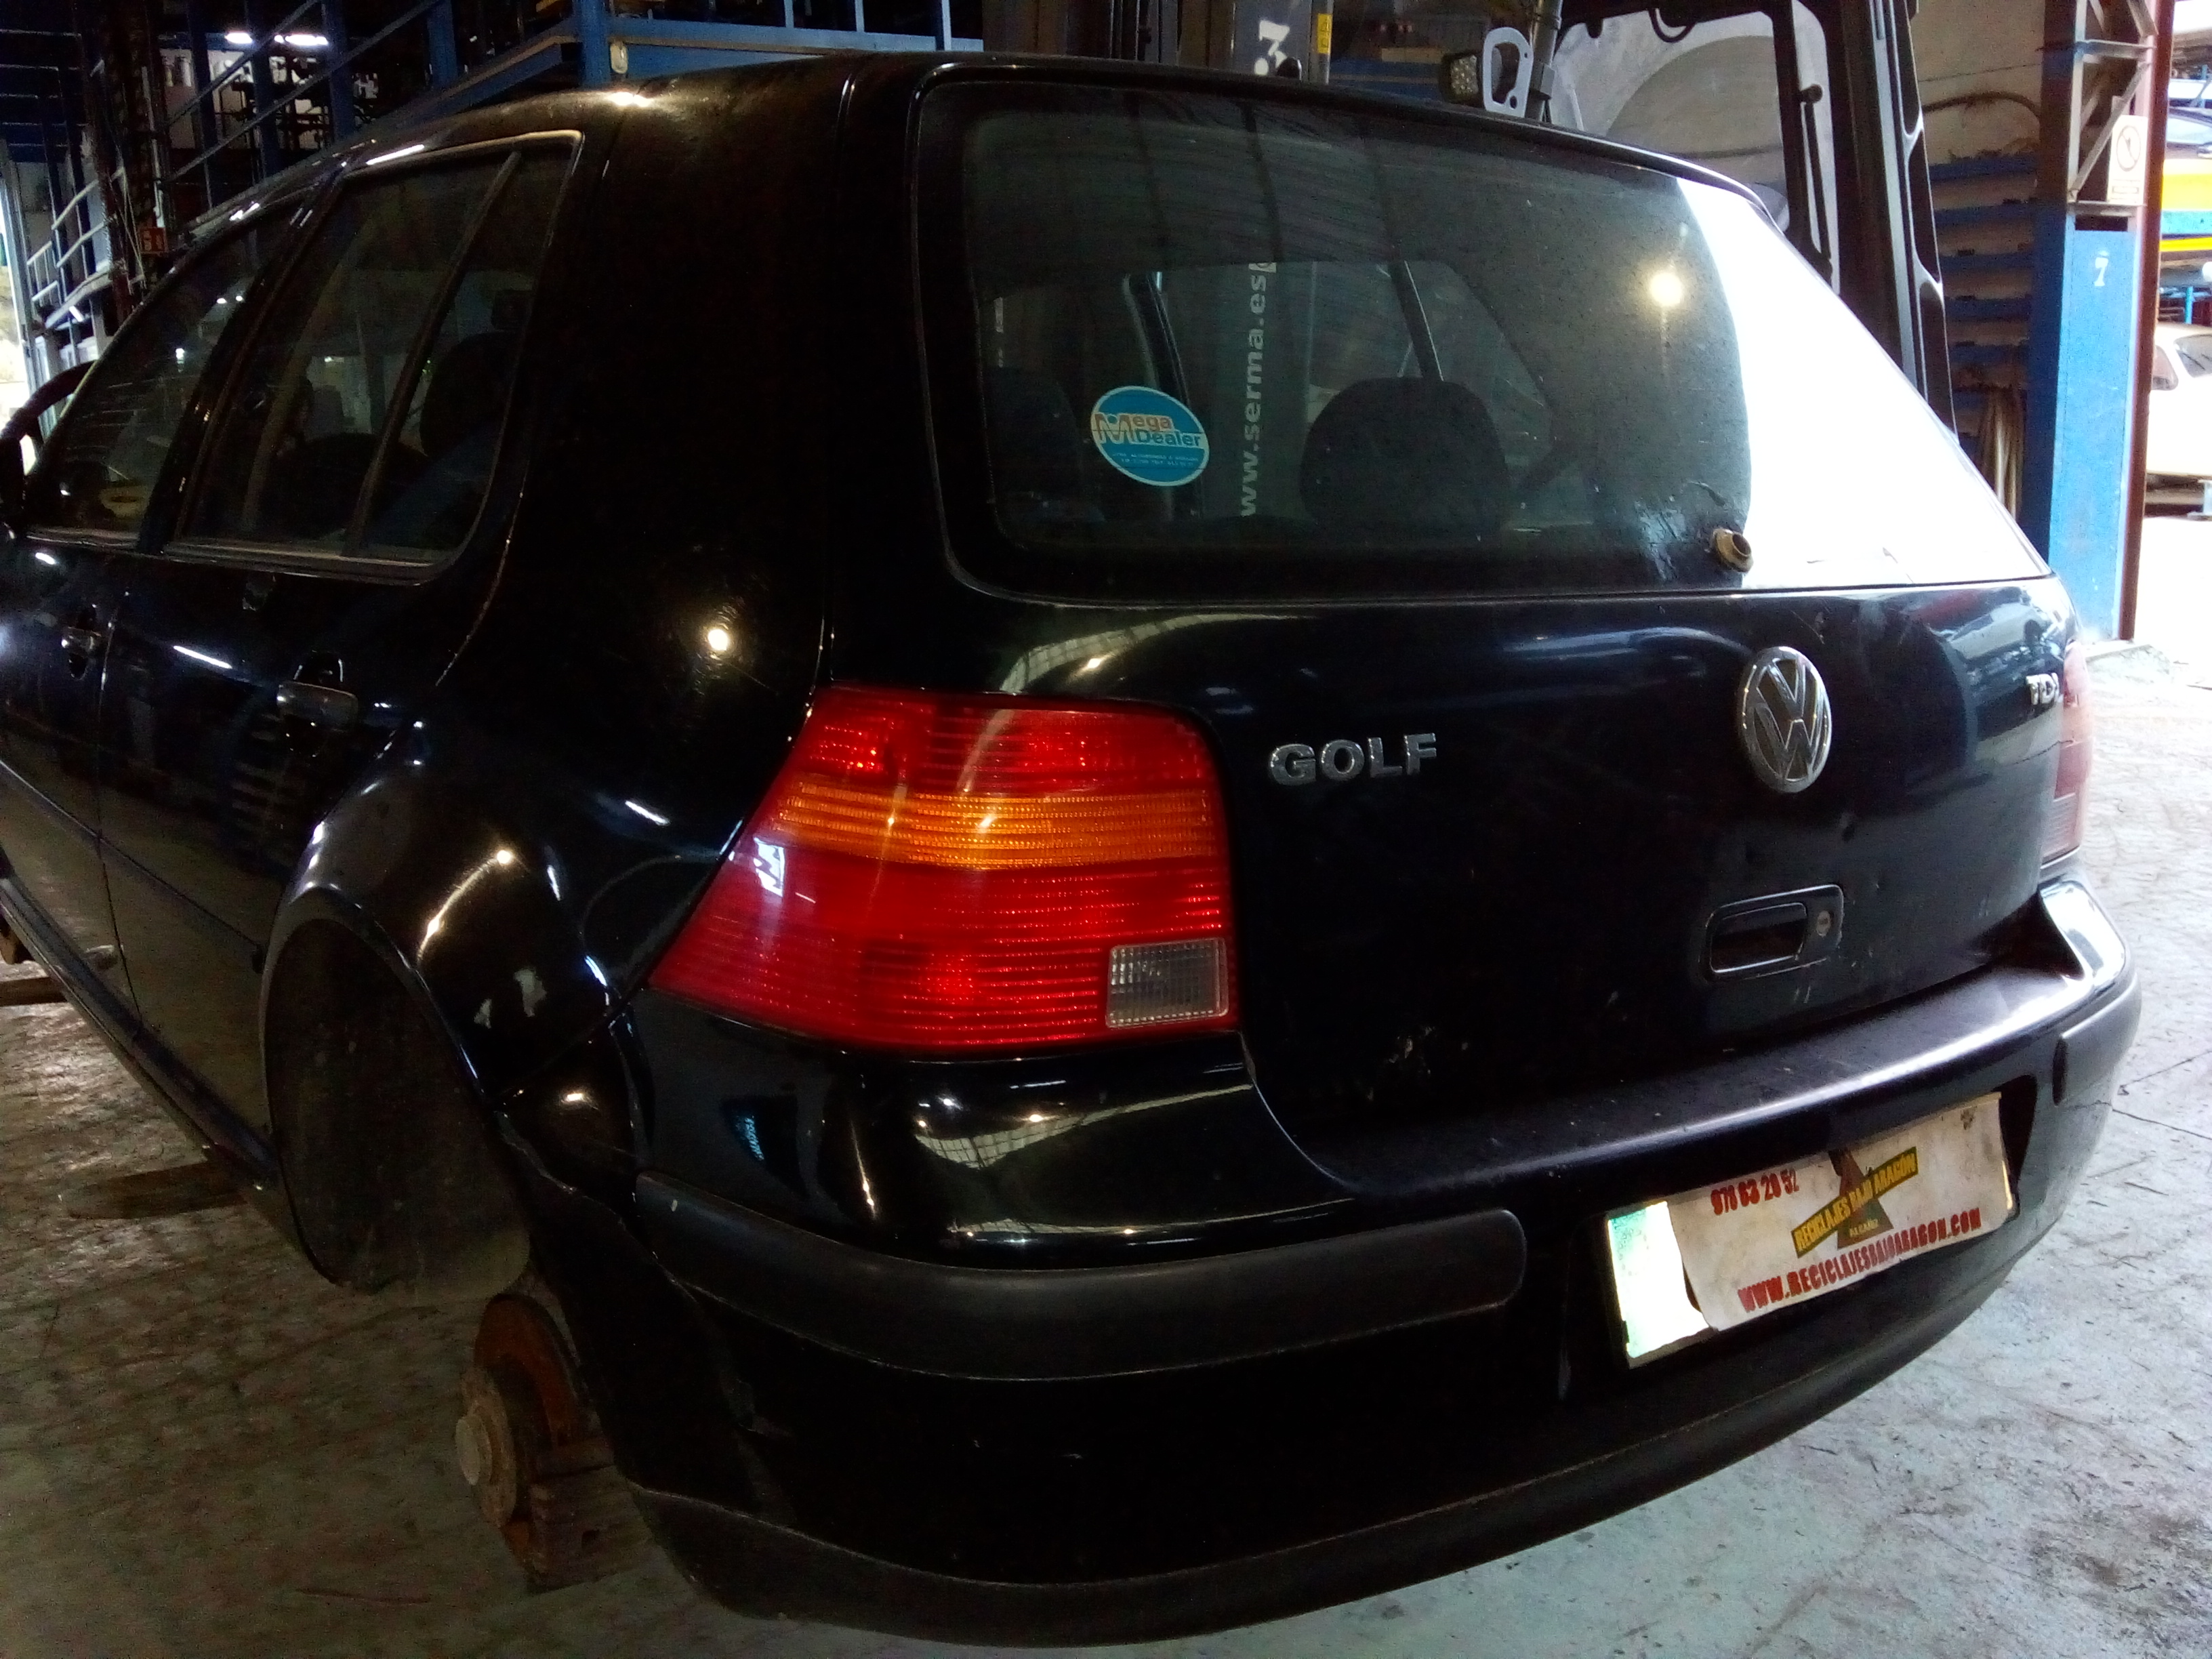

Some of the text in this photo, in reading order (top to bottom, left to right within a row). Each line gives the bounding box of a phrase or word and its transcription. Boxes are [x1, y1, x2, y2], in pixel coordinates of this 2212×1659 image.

[1094, 413, 1171, 443] Mega
[1134, 429, 1201, 447] Dealer
[1269, 733, 1437, 786] GOLF
[1794, 1196, 1851, 1251] RECICLAJES
